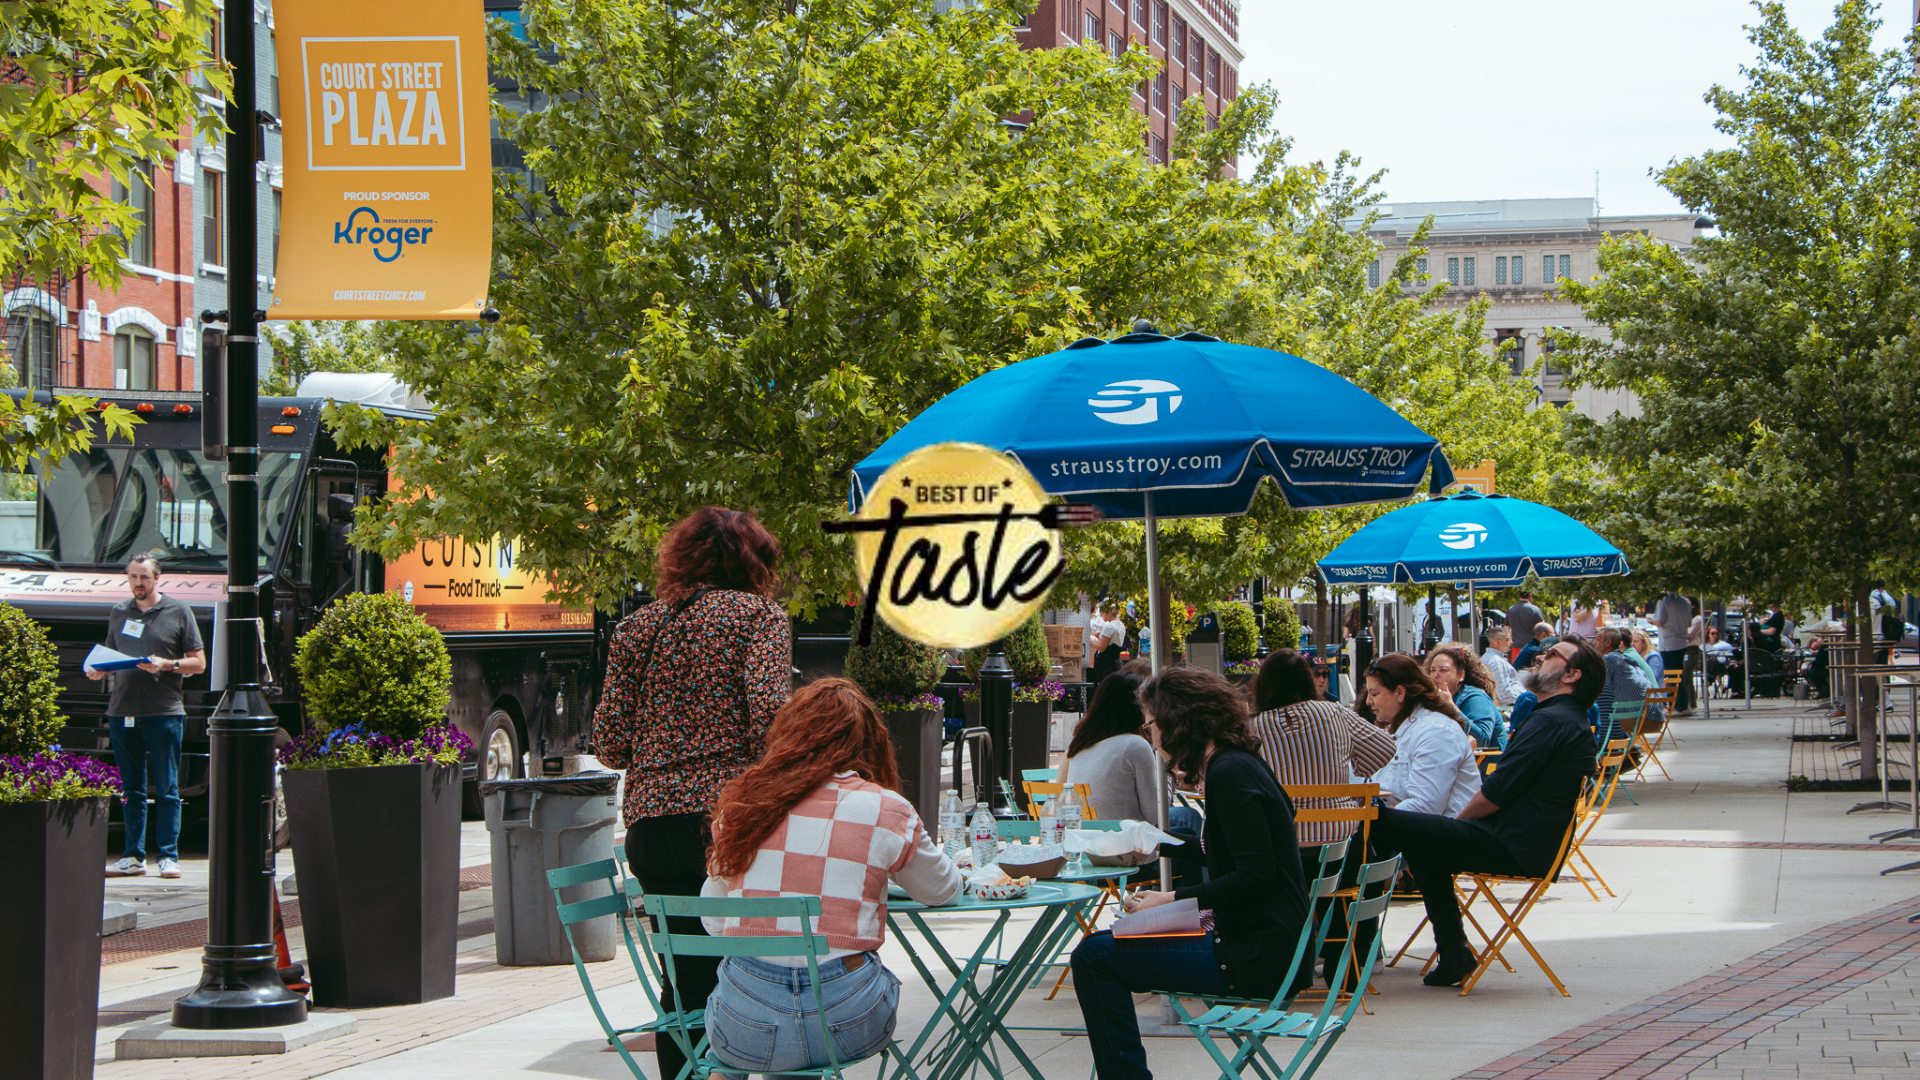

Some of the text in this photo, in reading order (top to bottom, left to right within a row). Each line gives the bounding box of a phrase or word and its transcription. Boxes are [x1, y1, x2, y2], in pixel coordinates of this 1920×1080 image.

[320, 62, 443, 90] COURT STREET
[321, 90, 447, 146] PLAZA
[343, 191, 430, 201] PROUD SPONSOR
[334, 206, 433, 263] Kroger
[333, 290, 426, 302] COURTSTREETCINCY.COM
[1521, 304, 1562, 317] UNION
[1289, 446, 1414, 468] STRAUSS TROY
[1051, 455, 1222, 477] strausstroy.com
[1420, 563, 1508, 575] strausstroy.com
[1542, 557, 1583, 571] STRAUSS
[1584, 556, 1607, 568] TROY
[1330, 566, 1367, 577] STRAUSS
[1365, 565, 1388, 575] TROY
[62, 578, 226, 589] CUIINE
[448, 578, 501, 598] Food Truck
[1203, 617, 1211, 628] P
